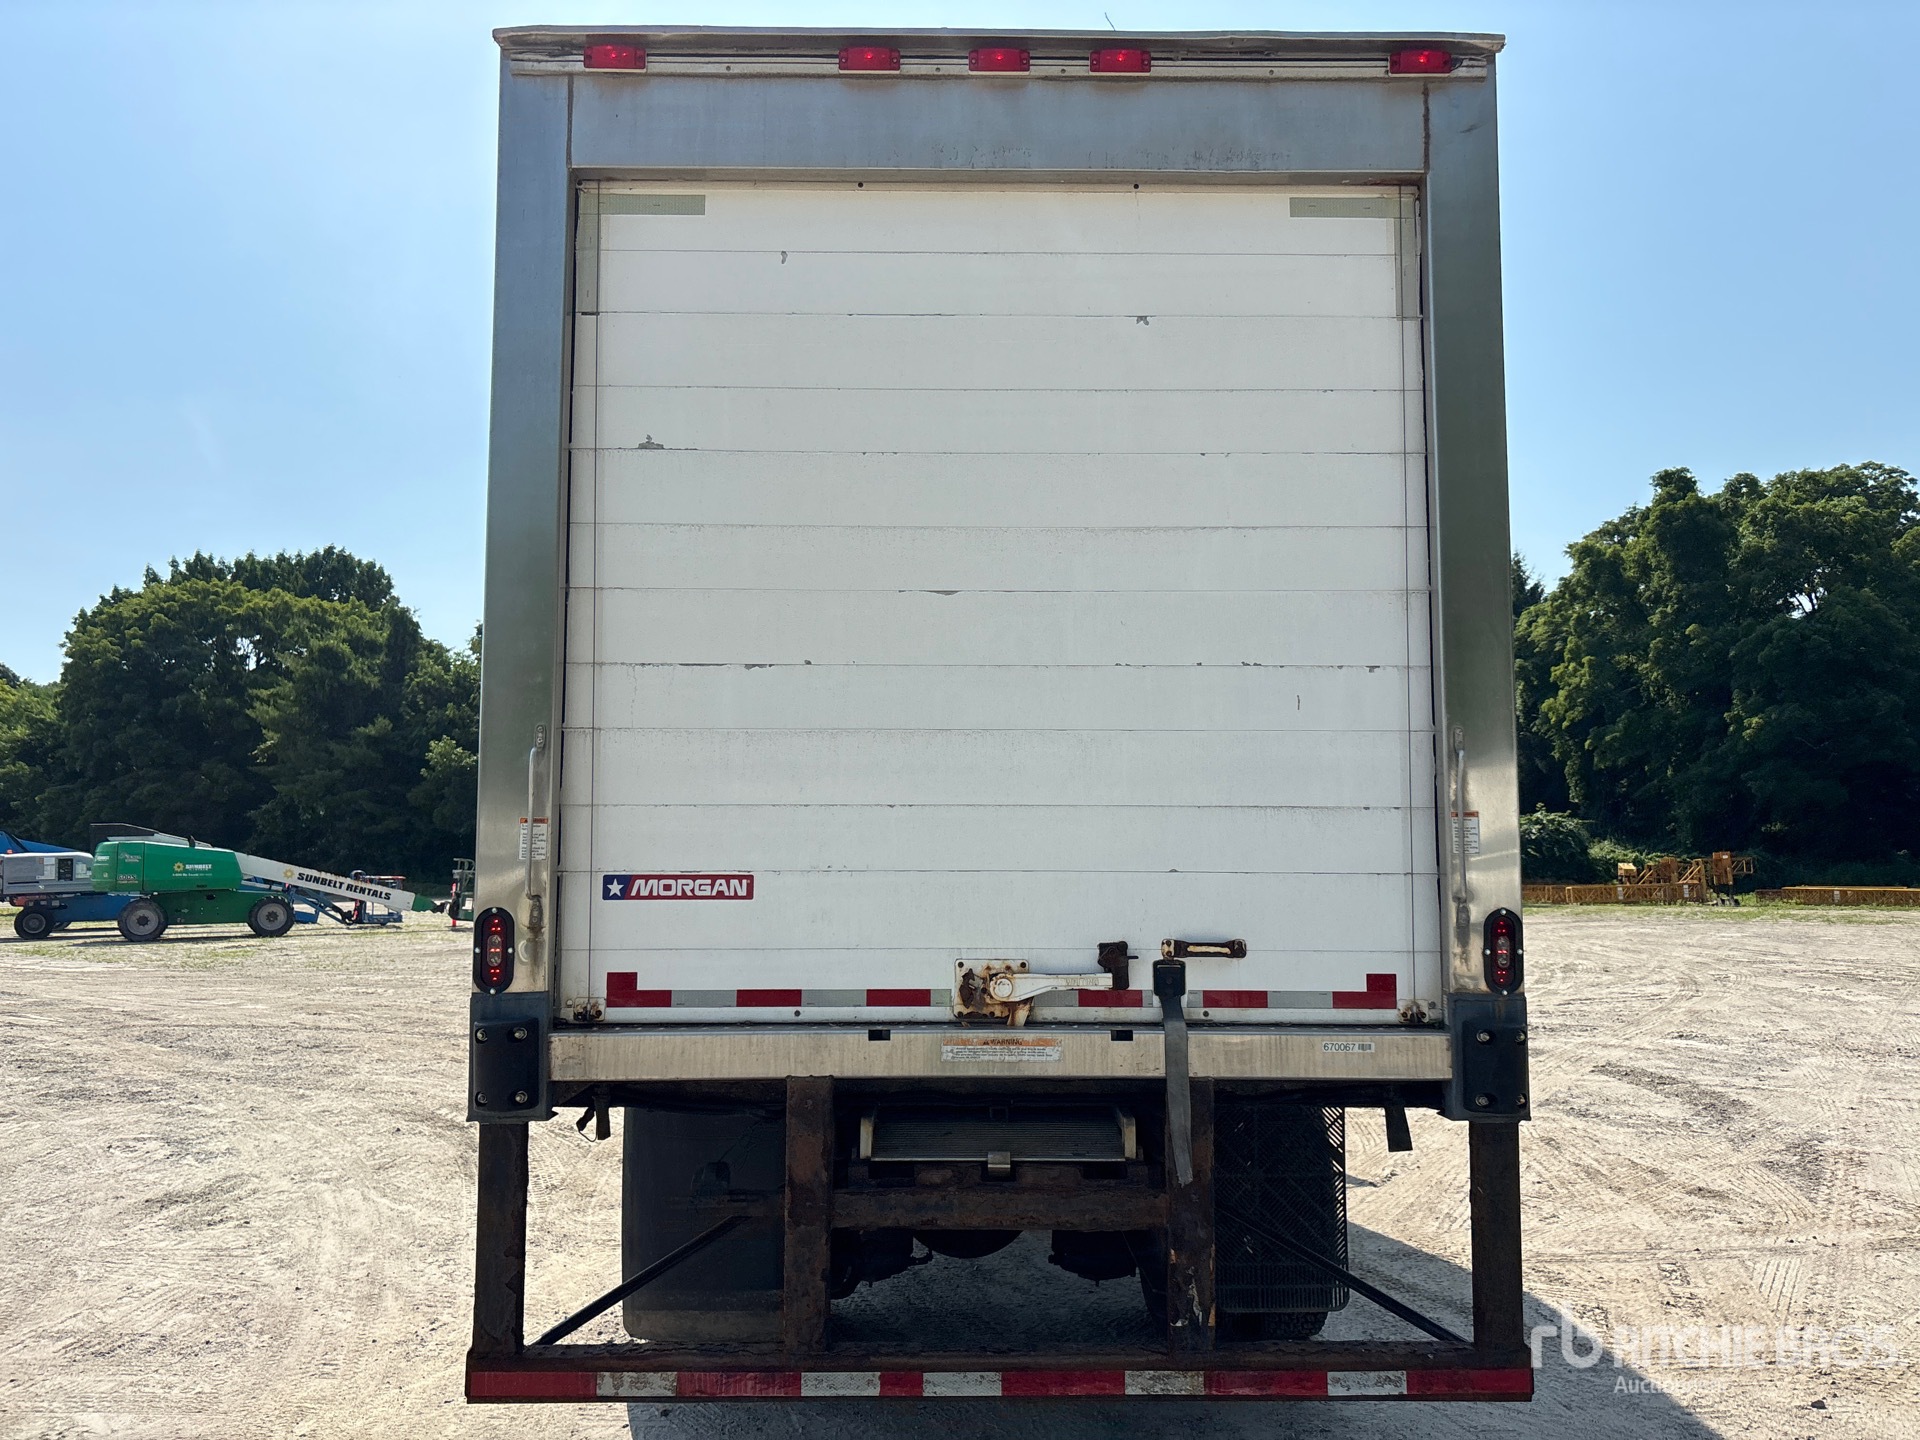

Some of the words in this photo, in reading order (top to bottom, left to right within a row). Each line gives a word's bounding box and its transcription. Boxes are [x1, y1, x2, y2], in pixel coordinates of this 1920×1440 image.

[297, 872, 345, 889] SUNBELT
[345, 883, 392, 901] RENTALS
[630, 879, 748, 896] MORGAN
[990, 1038, 1023, 1046] WARNING
[1323, 1042, 1356, 1051] 670067
